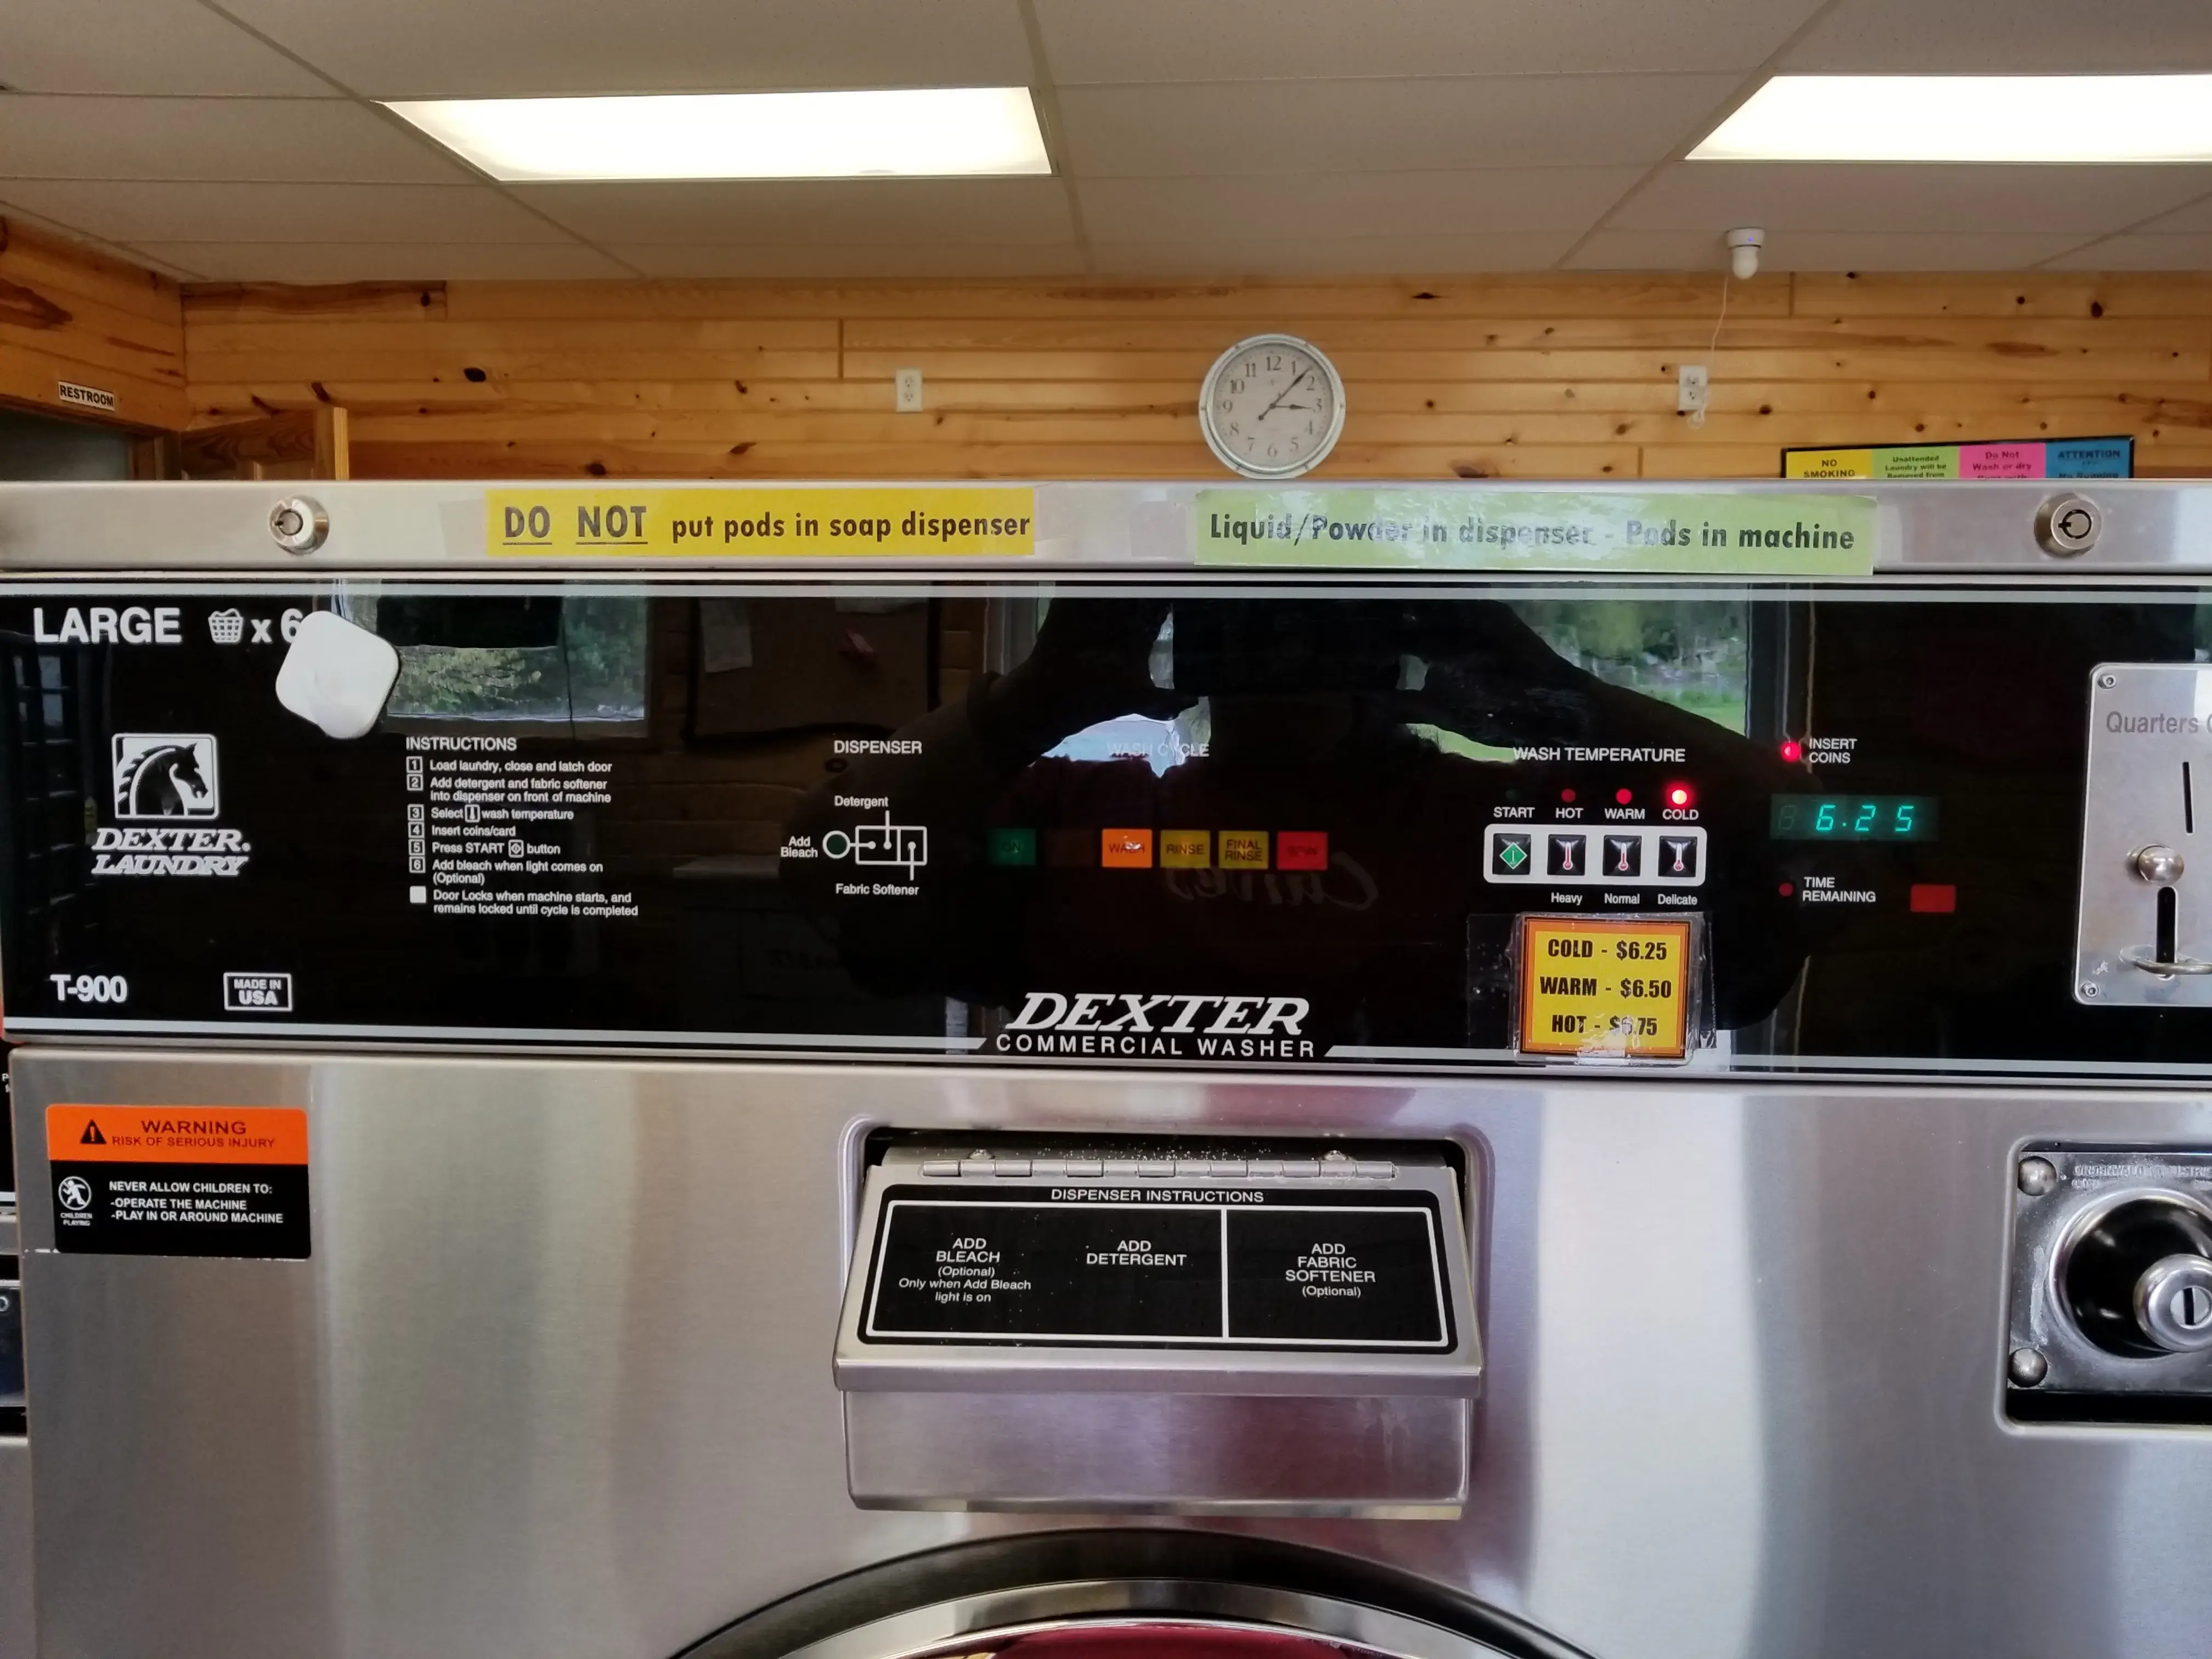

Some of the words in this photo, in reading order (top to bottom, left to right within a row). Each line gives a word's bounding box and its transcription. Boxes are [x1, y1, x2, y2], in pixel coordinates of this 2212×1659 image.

[1267, 356, 1282, 370] 12
[1246, 363, 1256, 377] 11
[1231, 380, 1245, 394] 10
[1306, 376, 1314, 391] 2
[60, 385, 114, 407] RESTROOM
[2058, 450, 2120, 459] ATTENTION
[2016, 462, 2032, 471] dry
[1804, 470, 1855, 478] SMOKING
[504, 505, 550, 538] DO
[578, 505, 647, 538] NOT
[672, 516, 714, 544] put
[725, 512, 785, 544] pods
[795, 512, 818, 537] in
[830, 519, 891, 543] soap
[902, 511, 1030, 543] dispenser
[1210, 514, 1412, 546] Liquid/Powder
[1459, 516, 1593, 549] dispenser
[1626, 520, 1690, 546] Pods
[1702, 522, 1726, 546] in
[1739, 522, 1854, 549] machine
[33, 608, 182, 644] LARGE
[251, 618, 272, 644] x
[280, 608, 303, 644] 6
[2106, 711, 2199, 733] Quarters
[406, 737, 517, 751] INSTRUCTIONS
[834, 740, 922, 754] DISPENSER
[1809, 738, 1858, 749] INSERT
[1513, 747, 1560, 761] WASH
[1564, 747, 1686, 762] TEMPERATURE
[1809, 752, 1851, 763] COINS
[430, 760, 456, 772] Load
[460, 760, 501, 774] laundry,
[505, 760, 533, 772] close
[536, 761, 556, 772] and
[560, 760, 585, 772] latch
[588, 760, 612, 772] door
[430, 777, 452, 788] Add
[455, 778, 505, 791] detergent
[508, 778, 528, 789] and
[531, 778, 561, 789] fabric
[563, 779, 607, 790] softener
[431, 791, 450, 801] into
[453, 791, 504, 804] dispenser
[508, 793, 521, 802] on
[524, 792, 548, 802] front
[552, 792, 562, 802] of
[566, 792, 611, 803] machine
[834, 795, 889, 809] Detergent
[431, 808, 463, 819] Select
[482, 809, 509, 819] wash
[511, 809, 574, 821] temperature
[1493, 807, 1535, 818] START
[1555, 808, 1584, 819] HOT
[1604, 808, 1645, 820] WARM
[1662, 809, 1699, 820] COLD
[1815, 805, 1915, 832] 6.25
[432, 825, 460, 837] Insert
[463, 825, 516, 837] coins/card
[788, 836, 811, 847] Add
[1226, 839, 1259, 850] FINAL
[432, 843, 462, 854] Press
[465, 843, 504, 854] START
[527, 843, 561, 855] button
[780, 847, 818, 858] Bleach
[1166, 843, 1204, 855] RINSE
[1225, 850, 1263, 861] RINSE
[91, 855, 249, 876] LAUNDRY
[432, 860, 453, 871] Add
[456, 860, 492, 871] bleach
[495, 861, 523, 872] when
[526, 861, 548, 873] light
[551, 862, 586, 872] comes
[589, 862, 603, 872] on
[433, 872, 485, 886] (Optional)
[1804, 877, 1835, 888] TIME
[836, 883, 870, 895] Fabric
[872, 883, 919, 895] Softener
[433, 890, 459, 901] Door
[462, 891, 493, 901] Locks
[496, 891, 524, 902] when
[527, 891, 572, 902] machine
[575, 892, 608, 904] starts,
[611, 893, 631, 903] and
[1550, 893, 1583, 905] Heavy
[1604, 893, 1640, 905] Normal
[1657, 894, 1698, 906] Delicate
[1802, 891, 1876, 902] REMAINING
[433, 904, 476, 914] remains
[478, 904, 513, 915] locked
[516, 904, 538, 915] until
[541, 904, 568, 917] cycle
[571, 905, 580, 915] is
[583, 905, 638, 918] completed
[1548, 939, 1593, 958] COLD
[1616, 940, 1667, 961] $6.25
[50, 974, 128, 1003] T-900
[234, 978, 267, 990] MADE
[270, 978, 281, 990] IN
[1540, 976, 1597, 996] WARM
[1620, 978, 1672, 998] $6.50
[239, 991, 278, 1006] USA
[1005, 991, 1310, 1036] DEXTER
[1551, 1014, 1587, 1032] HOT
[996, 1033, 1183, 1056] COMMERCIAL
[1197, 1037, 1314, 1059] WASHER
[140, 1119, 246, 1135] WARNING
[111, 1136, 140, 1147] RISK
[146, 1137, 162, 1147] OF
[167, 1137, 224, 1147] SERIOUS
[228, 1137, 275, 1148] INJURY
[109, 1181, 146, 1192] NEVER
[149, 1181, 189, 1193] ALLOW
[193, 1182, 250, 1194] CHILDREN
[253, 1183, 273, 1194] TO:
[1051, 1188, 1141, 1201] DISPENSER
[1147, 1189, 1264, 1203] INSTRUCTIONS
[110, 1198, 166, 1209] -OPERATE
[170, 1199, 192, 1209] THE
[195, 1199, 247, 1210] MACHINE
[111, 1210, 144, 1221] -PLAY
[146, 1211, 157, 1221] IN
[160, 1211, 177, 1221] OR
[179, 1211, 228, 1222] AROUND
[230, 1212, 283, 1223] MACHINE
[952, 1237, 986, 1249] ADD
[1117, 1240, 1152, 1252] ADD
[1311, 1243, 1346, 1255] ADD
[936, 1250, 1001, 1263] BLEACH
[1086, 1252, 1187, 1267] DETERGENT
[1297, 1256, 1357, 1268] FABRIC
[938, 1265, 995, 1278] (Optional)
[1285, 1269, 1376, 1283] SOFTENER
[899, 1278, 926, 1290] Only
[929, 1279, 961, 1289] when
[963, 1278, 987, 1290] Add
[991, 1279, 1031, 1290] Bleach
[935, 1291, 960, 1304] light
[963, 1292, 973, 1302] is
[975, 1293, 991, 1302] on
[1302, 1285, 1362, 1298] (Optional)
